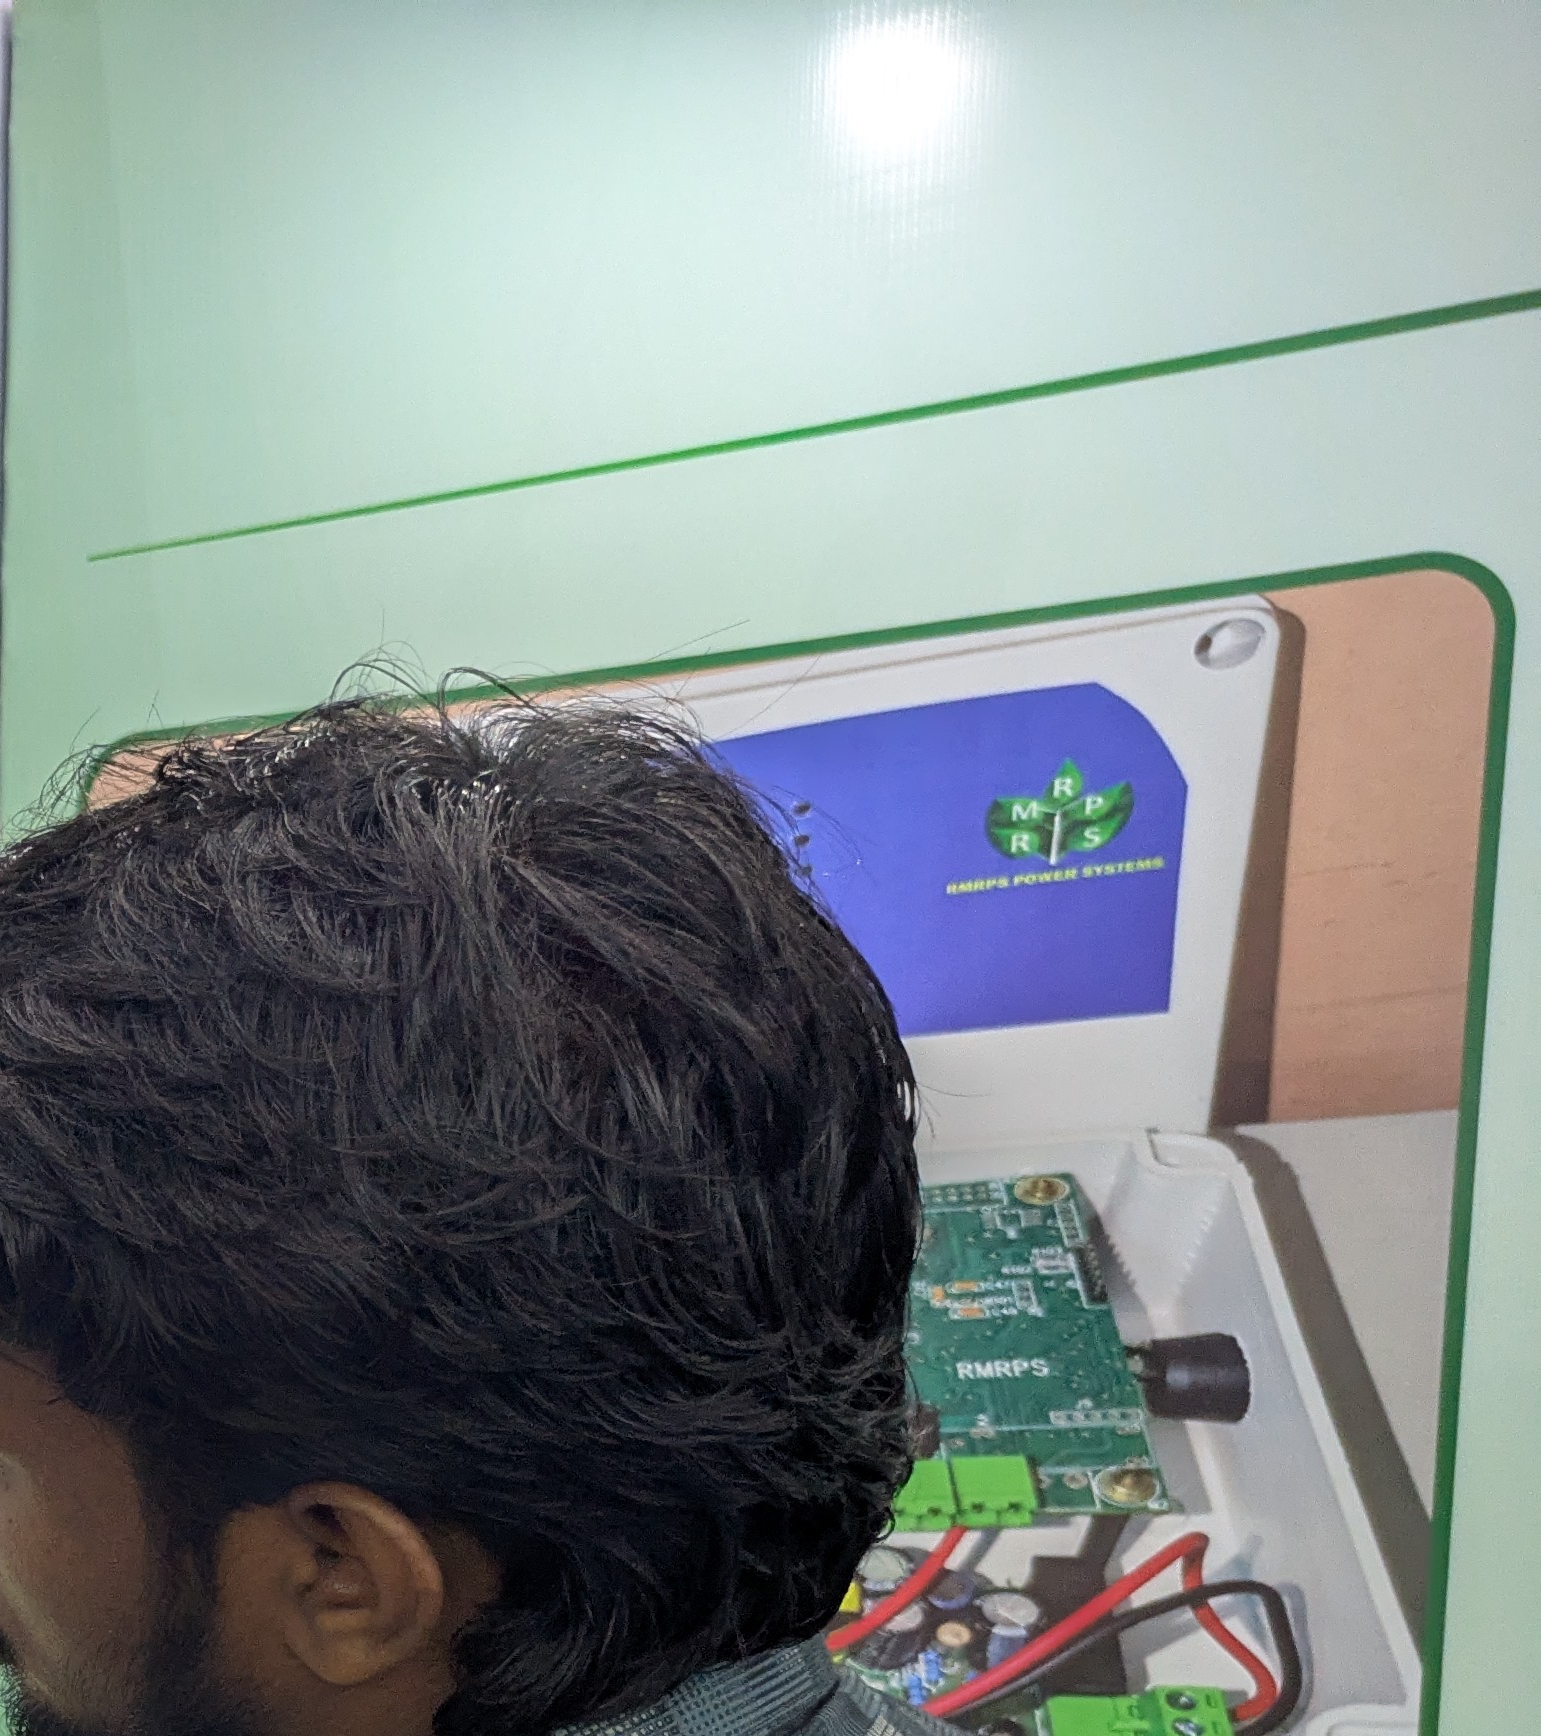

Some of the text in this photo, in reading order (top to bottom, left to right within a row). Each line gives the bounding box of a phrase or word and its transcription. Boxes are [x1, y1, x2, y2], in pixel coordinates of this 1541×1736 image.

[1013, 866, 1078, 886] POWER
[1082, 856, 1165, 878] SYSTEMS
[955, 1358, 1051, 1381] RMRPS
